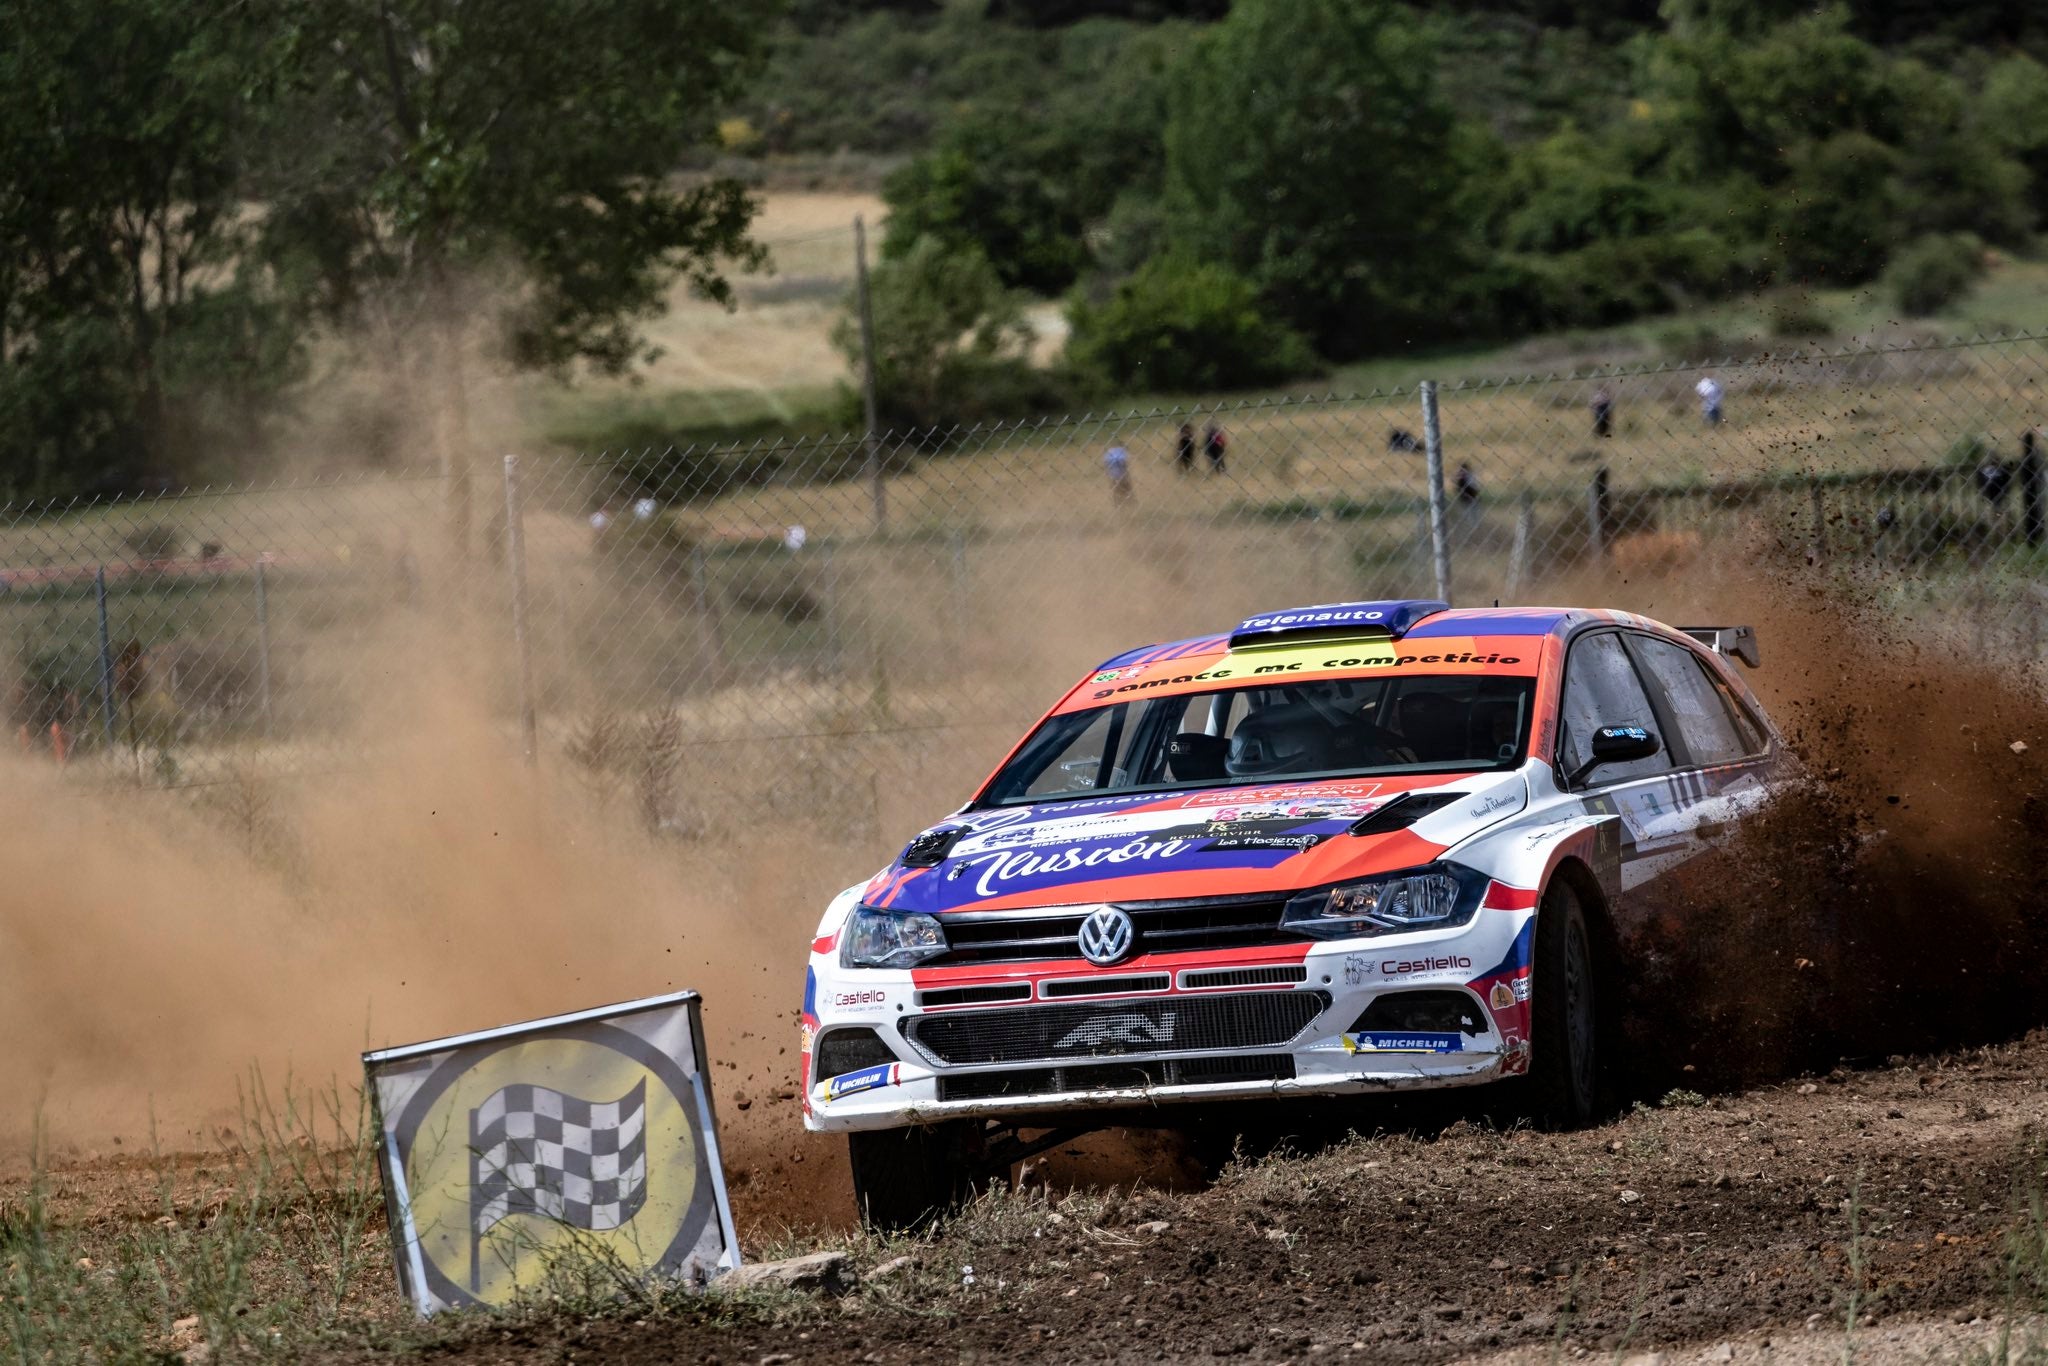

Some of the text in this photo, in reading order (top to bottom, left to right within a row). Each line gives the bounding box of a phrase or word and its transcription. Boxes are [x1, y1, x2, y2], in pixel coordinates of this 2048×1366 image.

[1242, 610, 1384, 629] Telenauto
[1093, 669, 1233, 700] gamace
[1253, 662, 1304, 675] mc
[1322, 652, 1521, 668] competicio
[1039, 792, 1184, 814] Telenauto
[1381, 955, 1472, 975] Castiello
[835, 989, 886, 1006] Castiello
[1376, 1038, 1449, 1049] MICHELIN
[840, 1072, 882, 1091] MICHELIN
